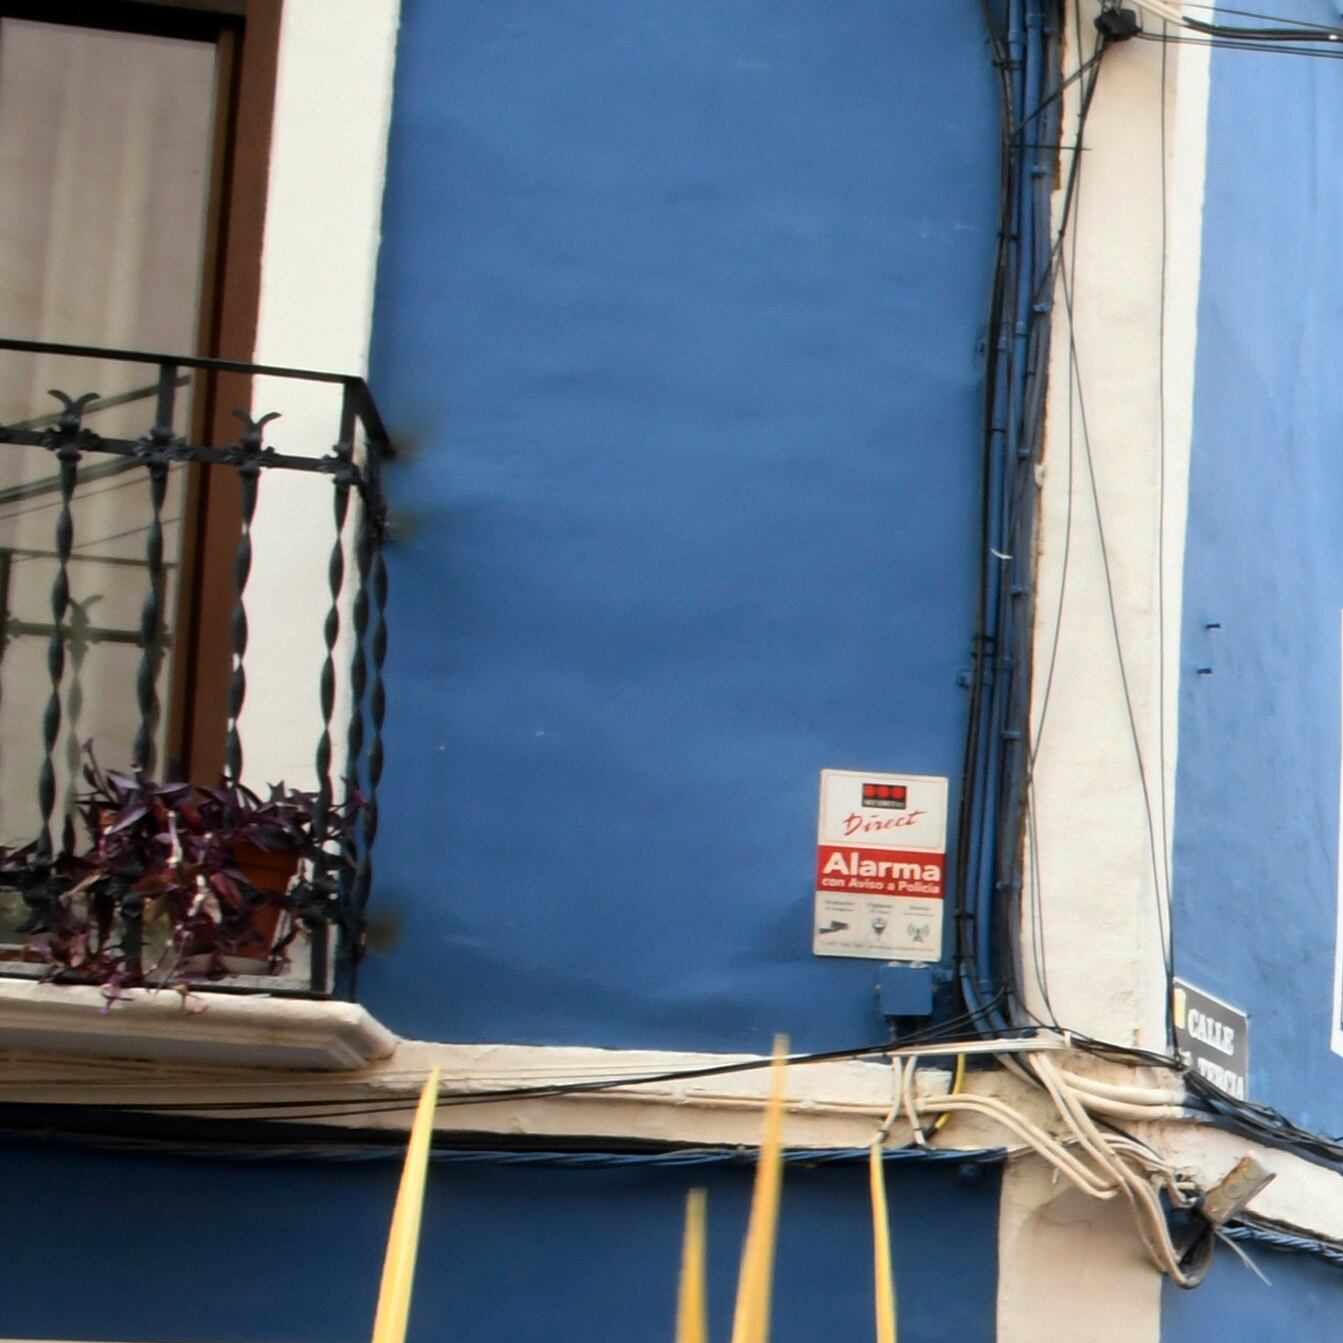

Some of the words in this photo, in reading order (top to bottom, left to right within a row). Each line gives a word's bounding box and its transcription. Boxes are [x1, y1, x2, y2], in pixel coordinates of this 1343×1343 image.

[844, 811, 925, 836] Direct
[823, 852, 940, 881] Alarma
[822, 877, 845, 887] con
[849, 879, 883, 890] Aviso
[887, 883, 895, 891] a
[1188, 1009, 1234, 1055] CALLE
